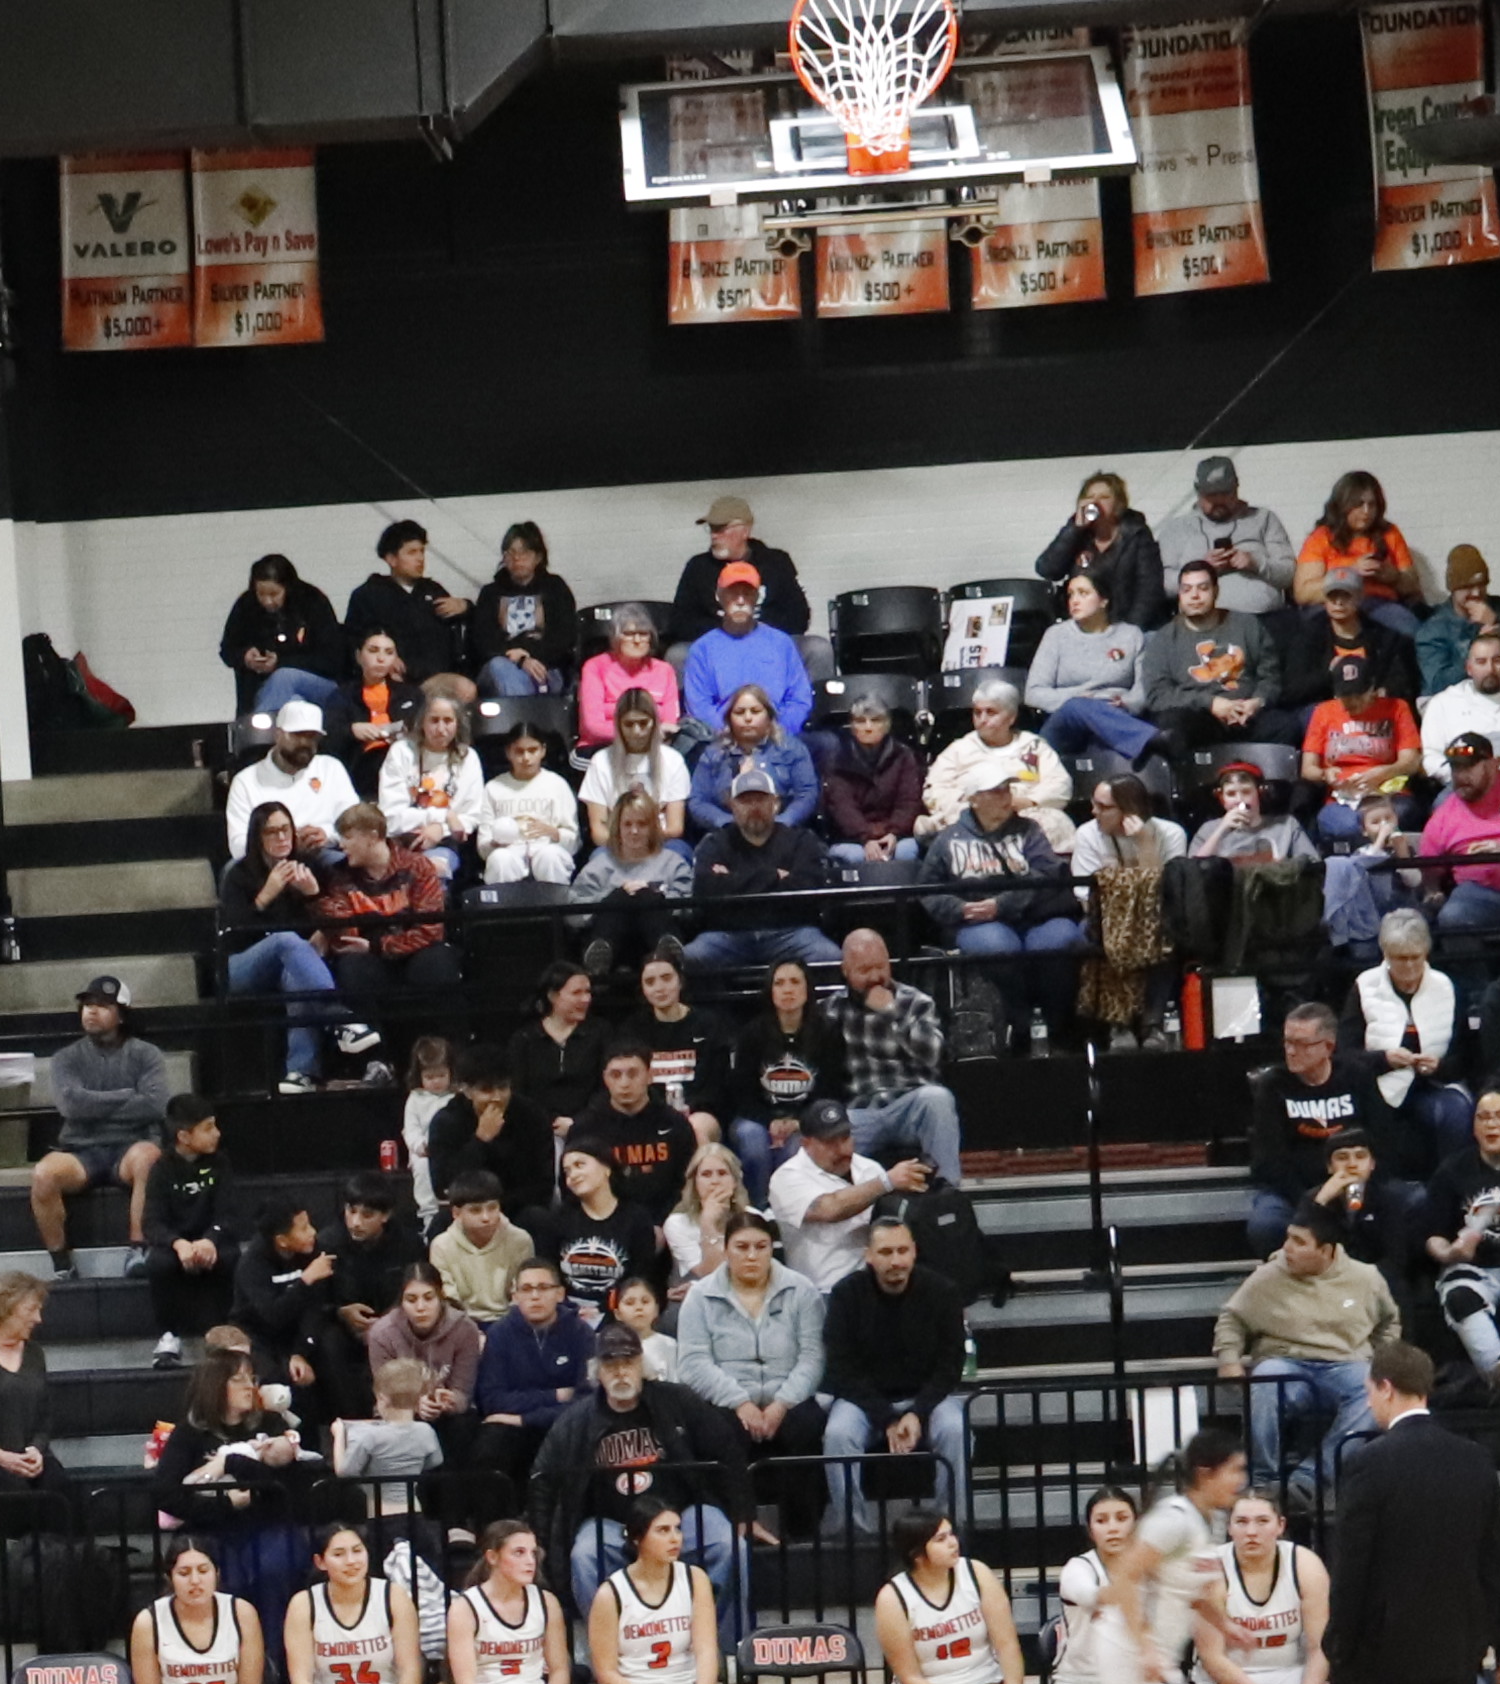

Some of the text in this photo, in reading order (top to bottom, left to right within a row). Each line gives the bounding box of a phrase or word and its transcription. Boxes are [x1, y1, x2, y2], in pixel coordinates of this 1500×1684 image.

[1124, 30, 1242, 60] FOUNDATIO
[1134, 144, 1254, 174] News Press
[1384, 200, 1482, 225] SILVER PARTNER
[197, 231, 316, 257] Lowe's Pay n Save
[1146, 222, 1251, 250] BRONZE PARTNER
[1412, 232, 1461, 254] $1,000
[73, 240, 177, 258] VALERO
[882, 250, 934, 269] PARTNER
[984, 239, 1089, 263] BRONZE PARTNER
[734, 258, 786, 277] PARTNER
[132, 284, 184, 305] PARTNER
[211, 281, 305, 302] SILVER PARTNER
[864, 281, 900, 302] $500
[1020, 273, 1056, 294] $500
[235, 312, 282, 336] $1,000
[949, 838, 1030, 880] DUMS
[1286, 1094, 1355, 1122] DUMAS
[315, 1635, 389, 1659] DEMONETTES
[753, 1634, 847, 1665] DUMAS
